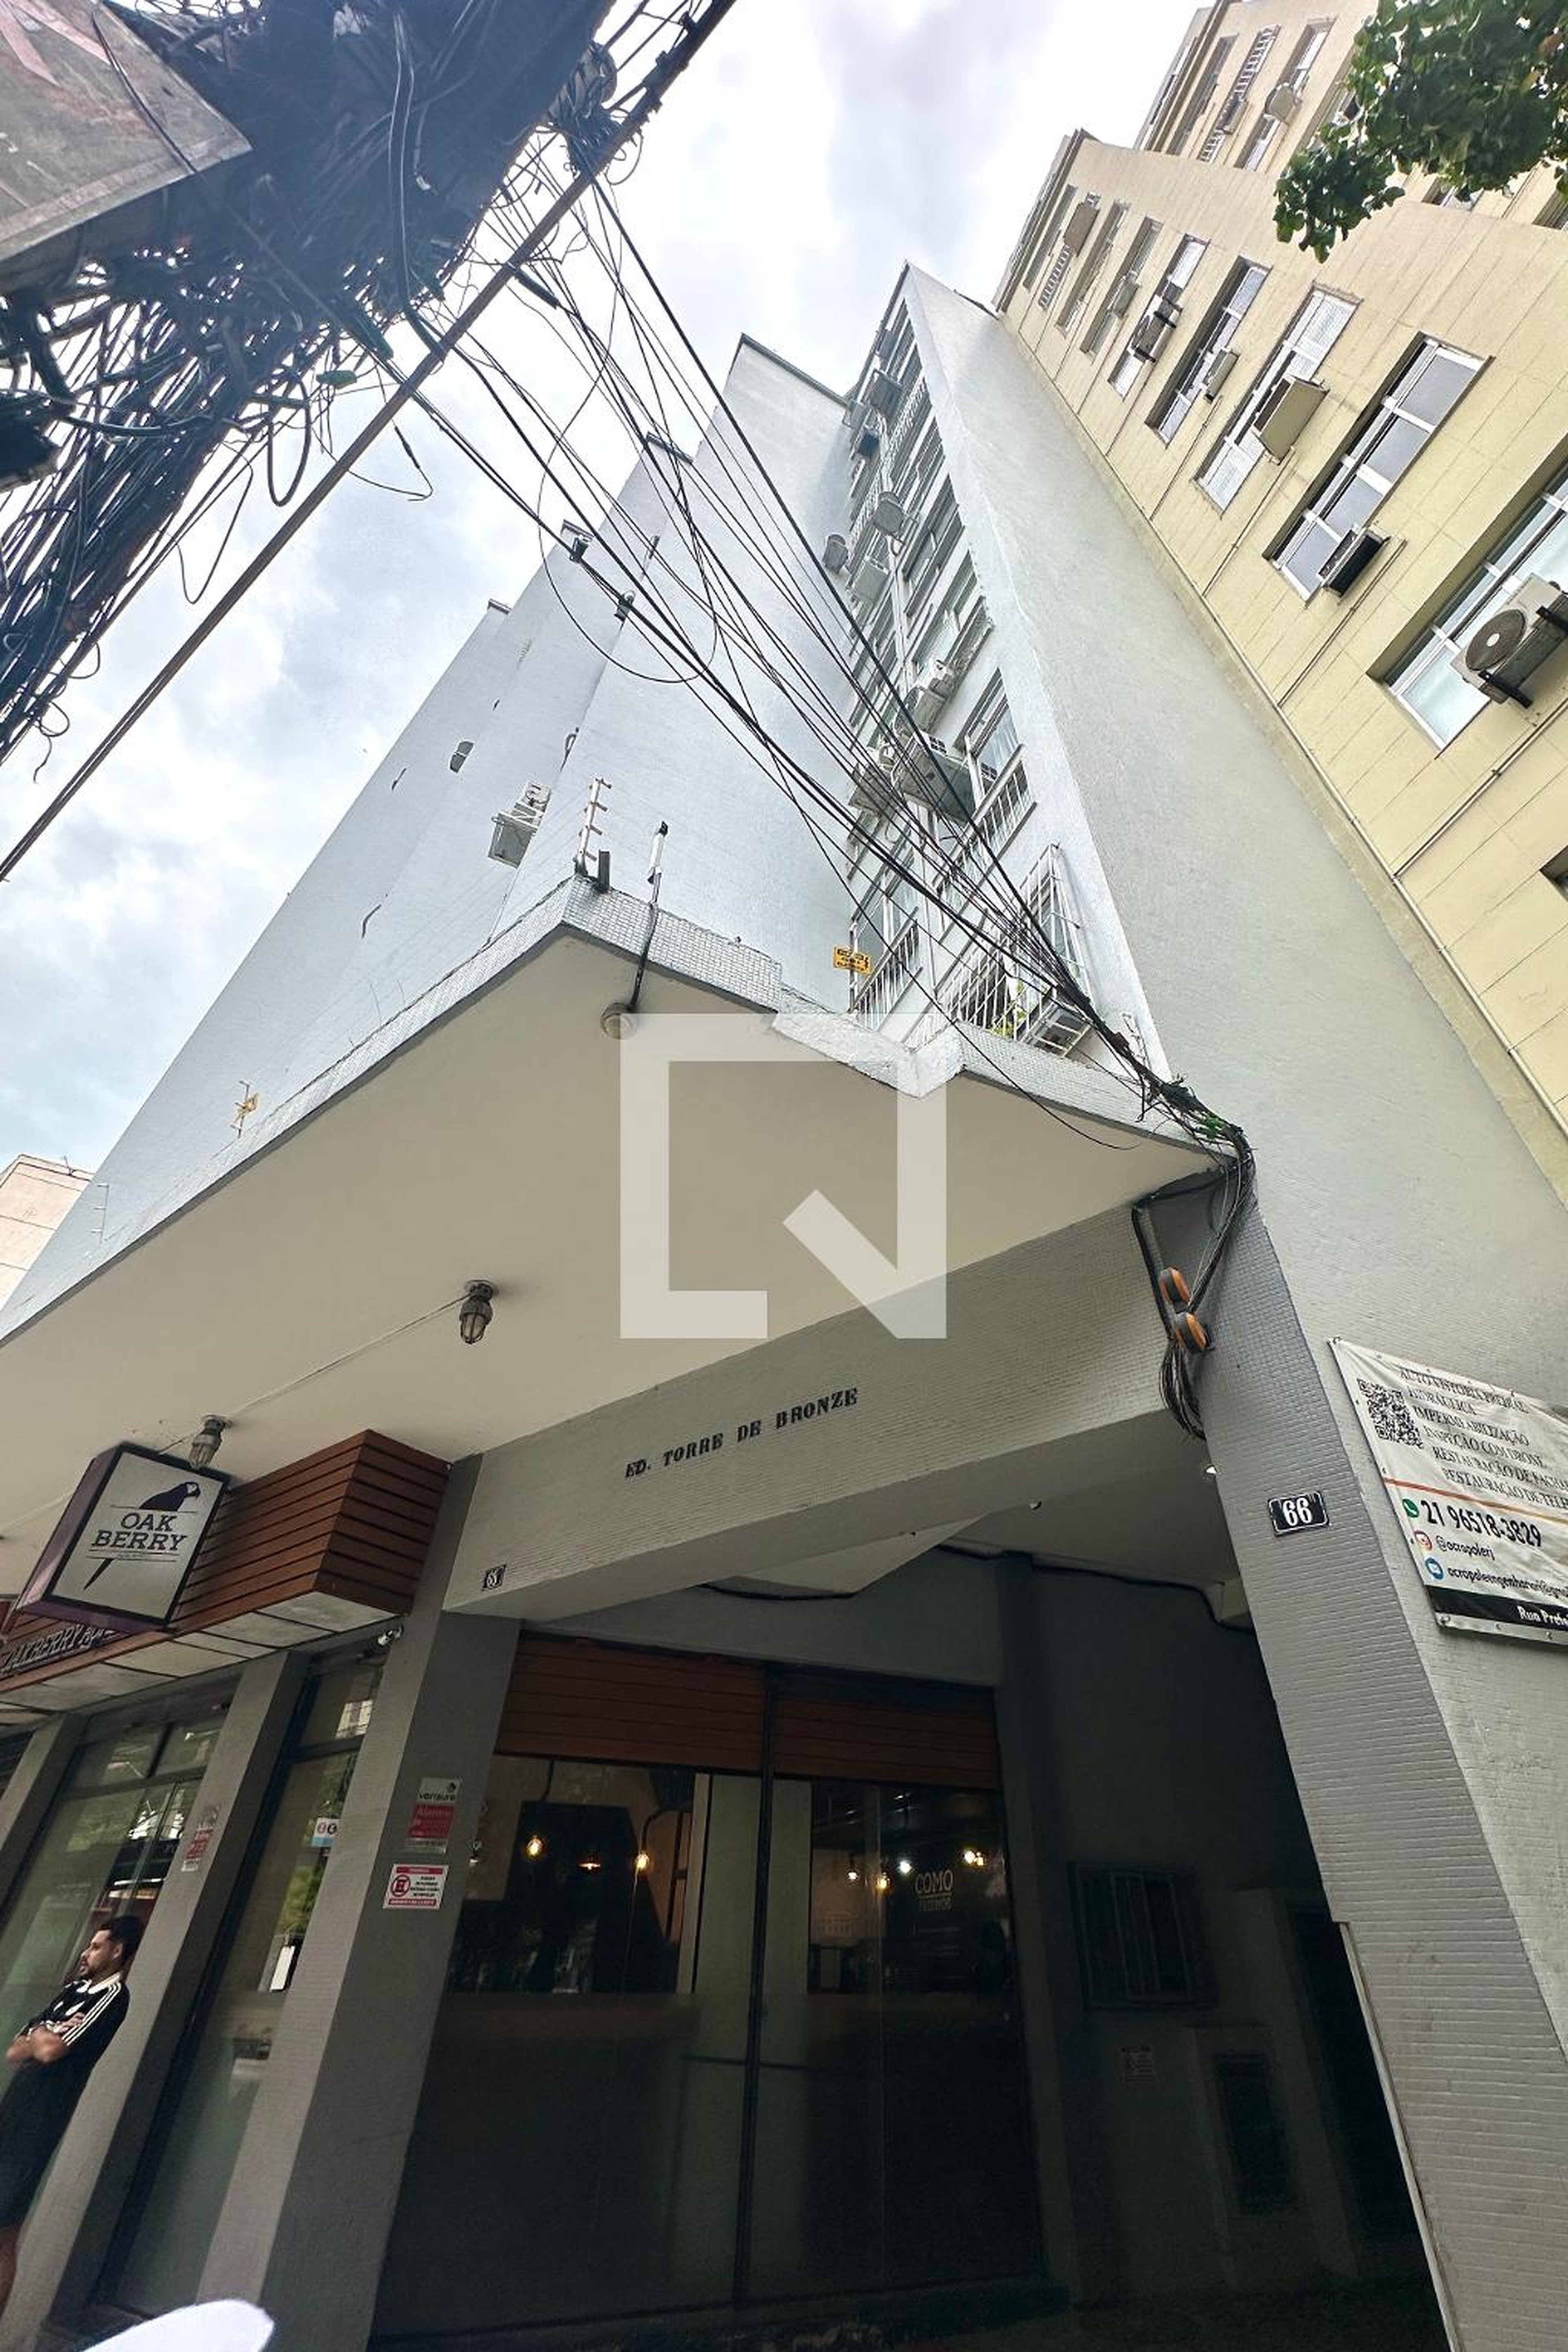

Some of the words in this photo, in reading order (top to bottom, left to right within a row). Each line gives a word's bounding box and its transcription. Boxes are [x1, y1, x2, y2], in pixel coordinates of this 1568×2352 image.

[624, 1459, 651, 1479] ED.
[662, 1432, 724, 1467] TORRE
[737, 1420, 762, 1443] DE
[775, 1387, 858, 1430] BRONZE
[121, 1512, 177, 1532] OAK
[1283, 1497, 1312, 1526] 66
[1421, 1499, 1445, 1527] 21
[1447, 1505, 1543, 1547] 96518-3829
[91, 1530, 188, 1550] BERRY
[1517, 1605, 1541, 1622] Rua
[915, 1869, 953, 1894] COMO
